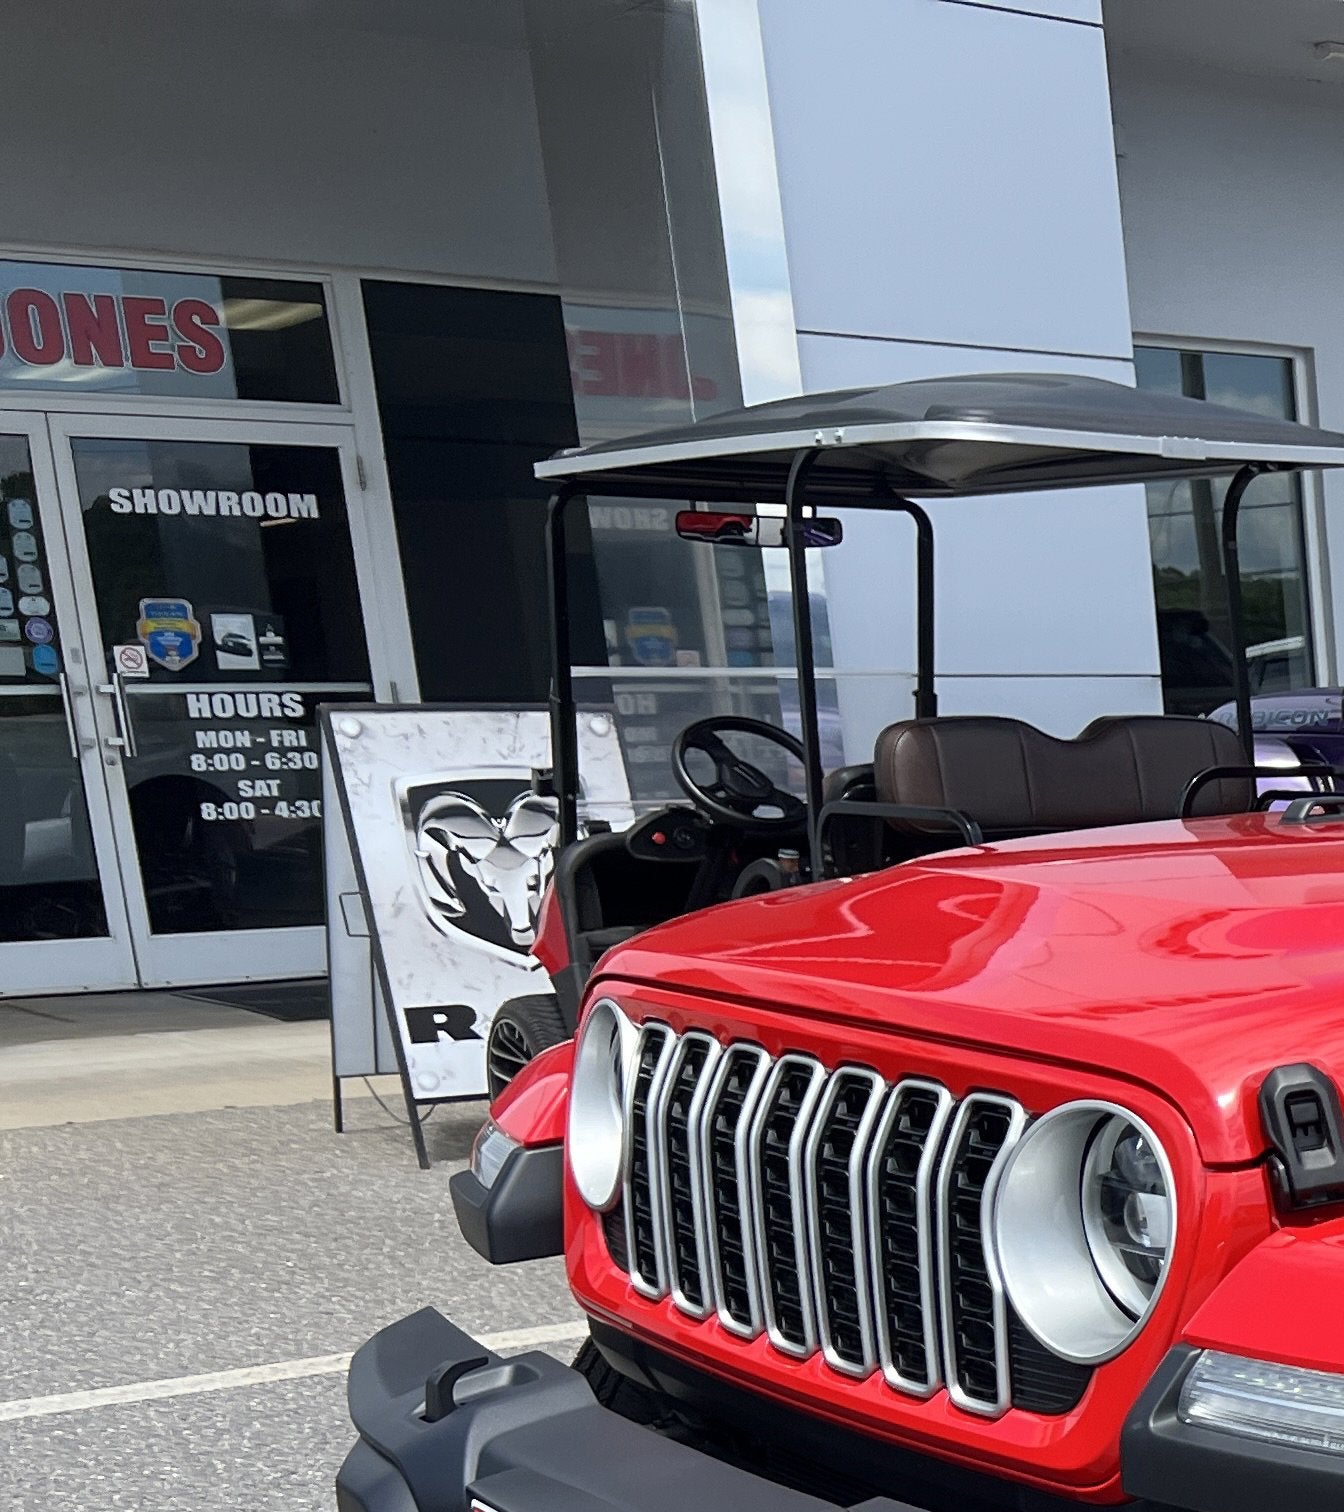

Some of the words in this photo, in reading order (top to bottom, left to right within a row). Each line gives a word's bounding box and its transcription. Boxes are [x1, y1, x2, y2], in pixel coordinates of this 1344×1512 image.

[0, 287, 226, 375] ONES
[108, 487, 319, 519] SHOWROOM
[186, 693, 305, 719] HOURS
[195, 730, 252, 748] MON
[269, 729, 308, 748] FRI
[190, 753, 247, 772] 8:00
[264, 752, 319, 771] 6:30
[237, 779, 281, 798] SAT
[200, 801, 256, 821] 8:00
